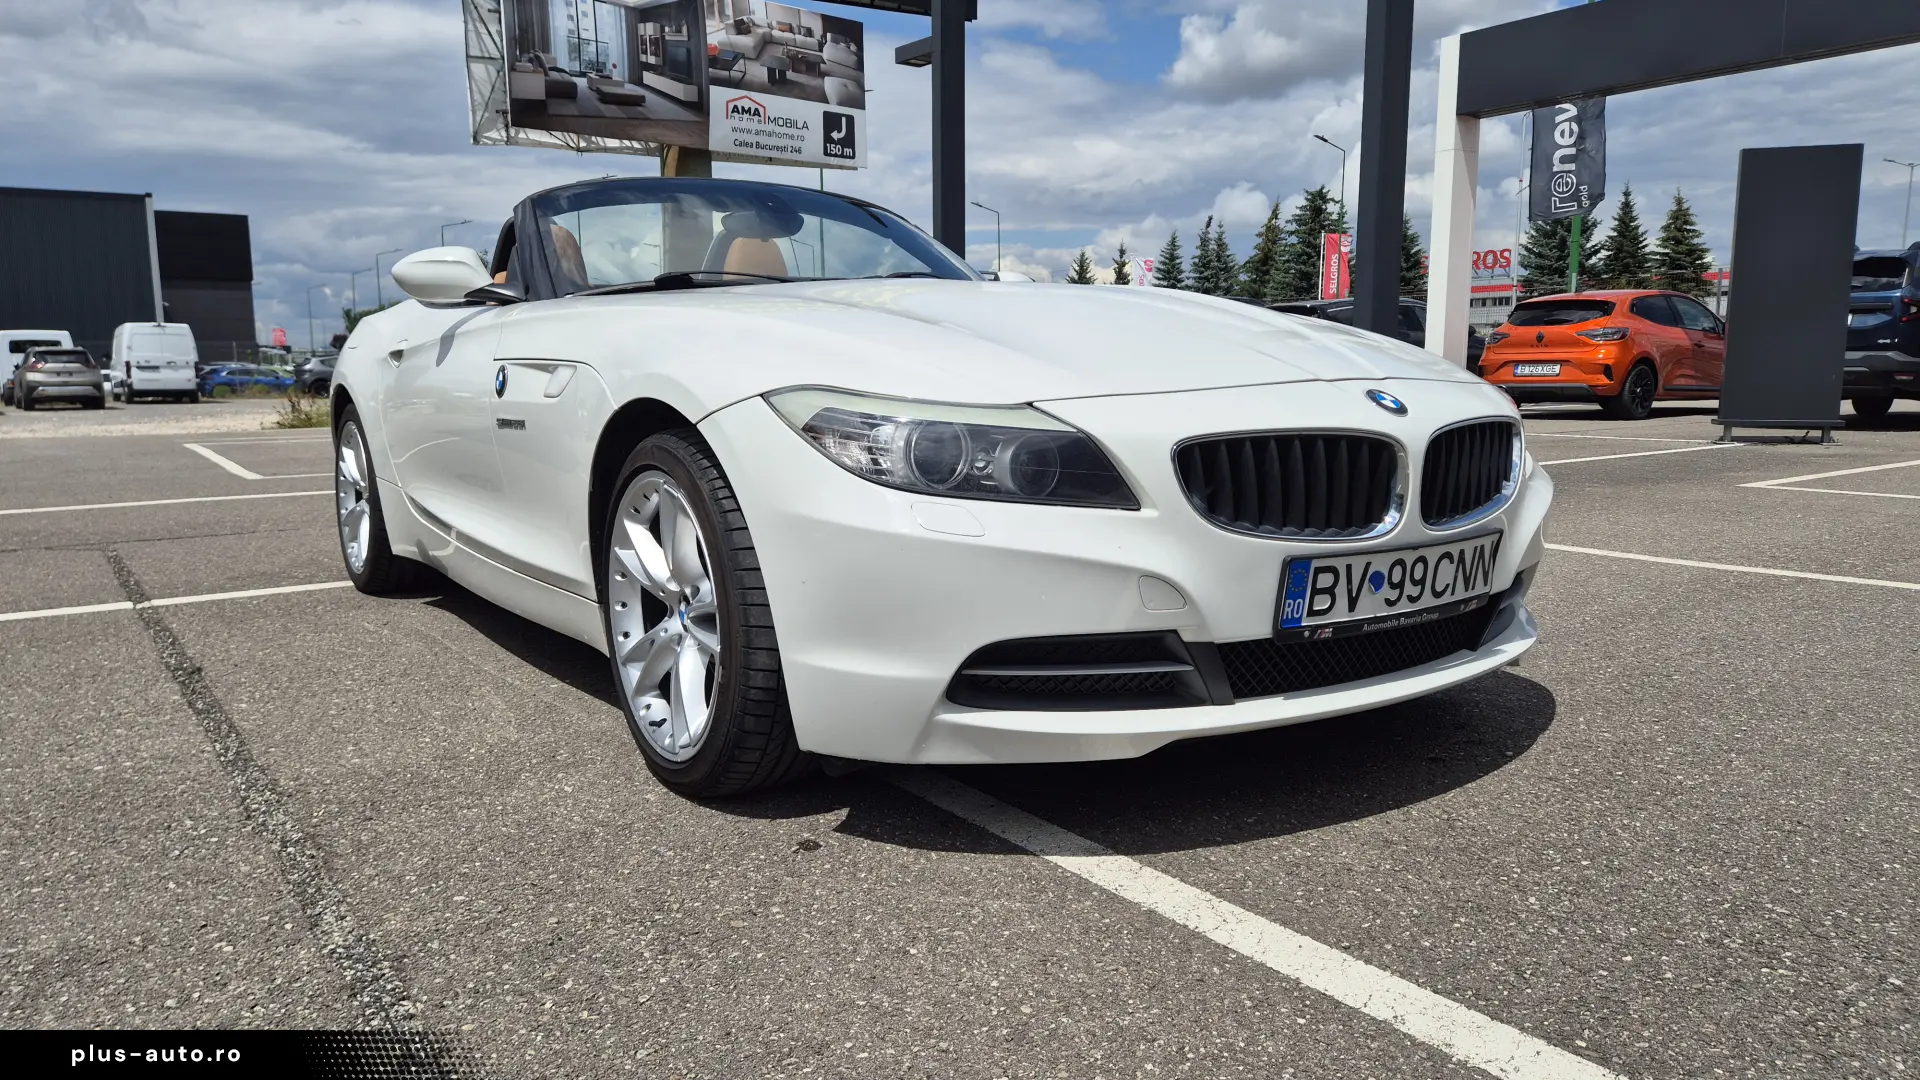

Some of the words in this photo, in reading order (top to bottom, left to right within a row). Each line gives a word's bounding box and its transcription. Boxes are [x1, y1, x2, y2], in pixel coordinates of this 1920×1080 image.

[731, 105, 761, 117] AMA
[730, 115, 762, 125] home
[767, 116, 810, 131] MOBILA
[731, 126, 805, 142] www.amahome.ro
[733, 138, 754, 149] Calea
[755, 141, 789, 154] București
[789, 145, 802, 155] 246
[826, 143, 842, 155] 150
[843, 147, 853, 157] m
[1329, 253, 1339, 294] SELGROS
[1283, 598, 1304, 620] RO
[1362, 619, 1399, 632] Automobile
[1399, 615, 1421, 625] Bavaria
[1422, 612, 1439, 621] Group
